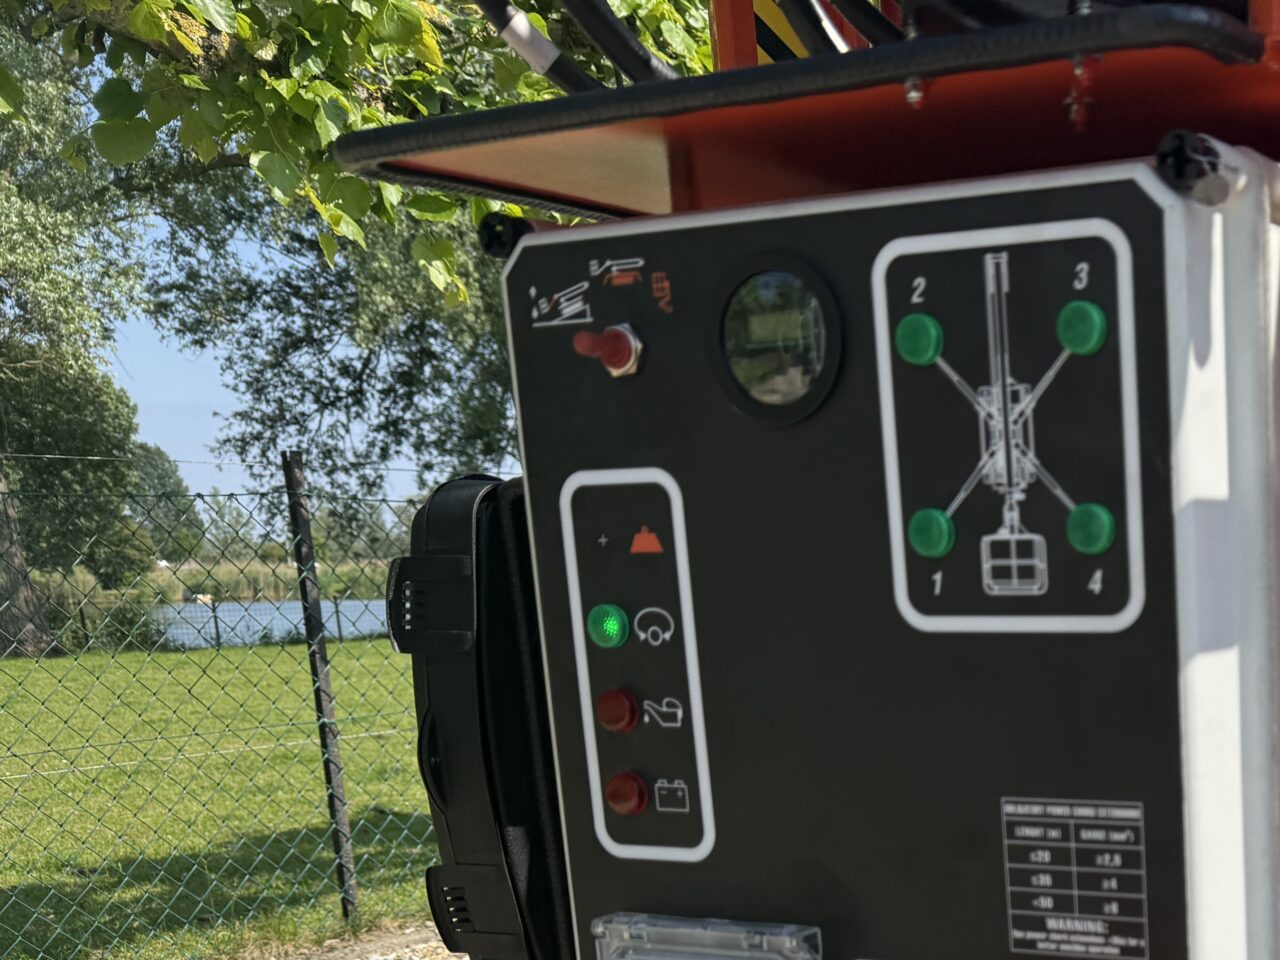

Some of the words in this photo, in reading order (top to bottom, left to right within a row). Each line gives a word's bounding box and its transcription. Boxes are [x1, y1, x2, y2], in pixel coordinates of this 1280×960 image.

[1072, 261, 1090, 291] 3
[910, 276, 928, 304] 2
[931, 570, 943, 596] 1
[1087, 568, 1104, 595] 4
